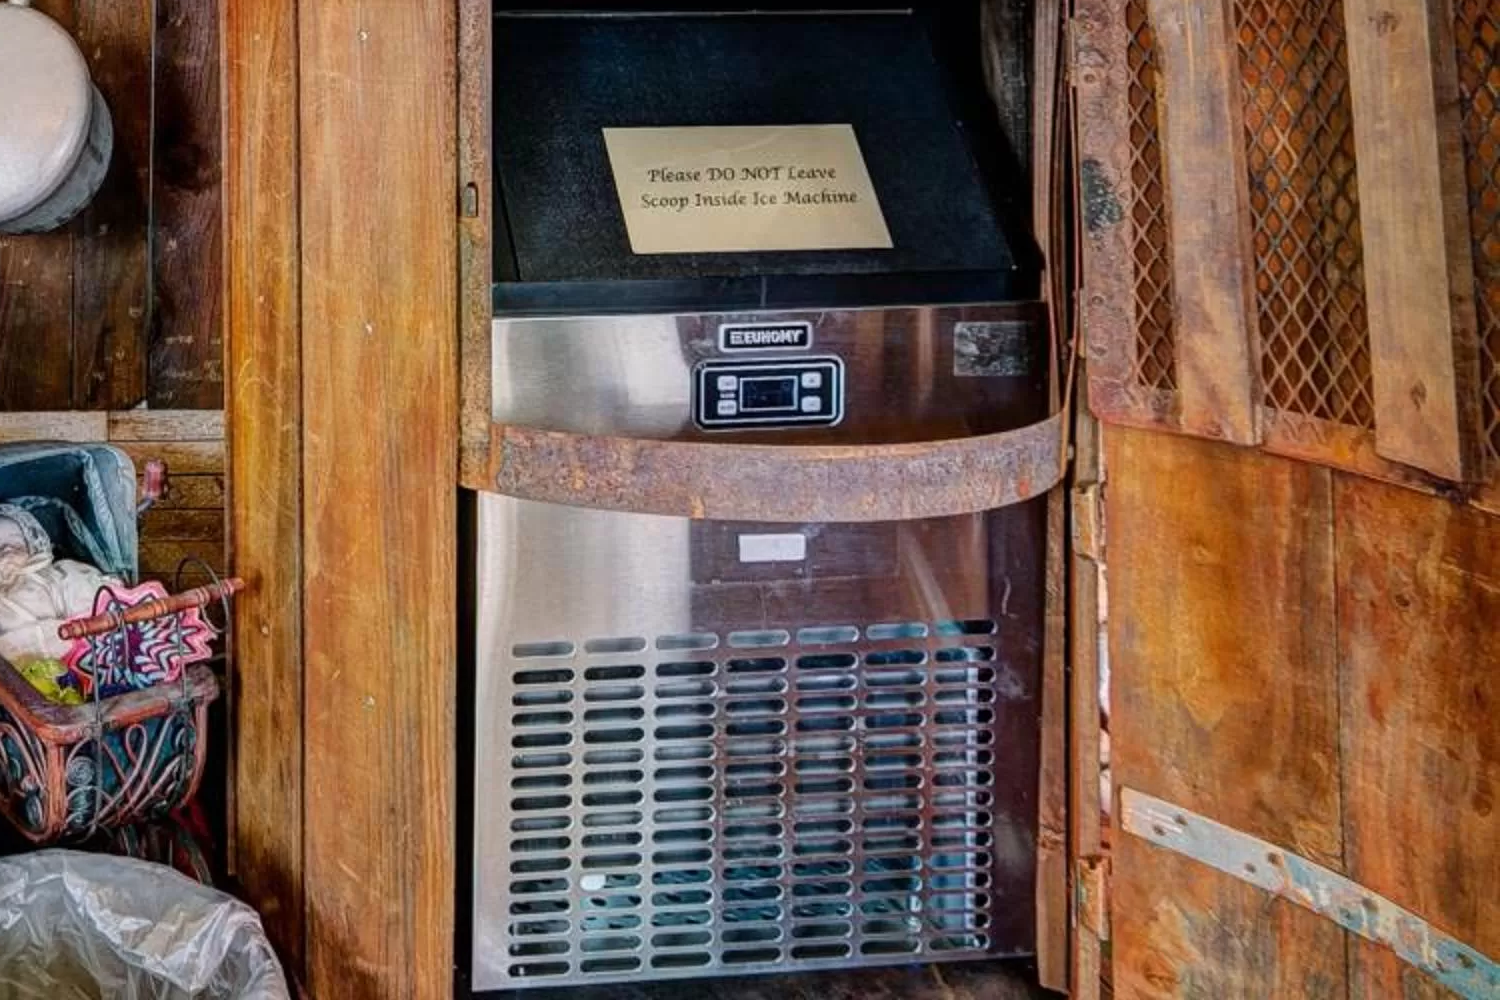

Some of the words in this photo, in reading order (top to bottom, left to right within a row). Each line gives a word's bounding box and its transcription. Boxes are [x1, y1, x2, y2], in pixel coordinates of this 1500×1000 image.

[647, 167, 701, 183] Please
[706, 167, 735, 181] DO
[740, 165, 784, 181] NOT
[788, 165, 837, 180] Leave
[640, 192, 689, 213] Scoop
[694, 189, 747, 207] Inside
[752, 191, 777, 206] Ice
[782, 187, 858, 205] Machine
